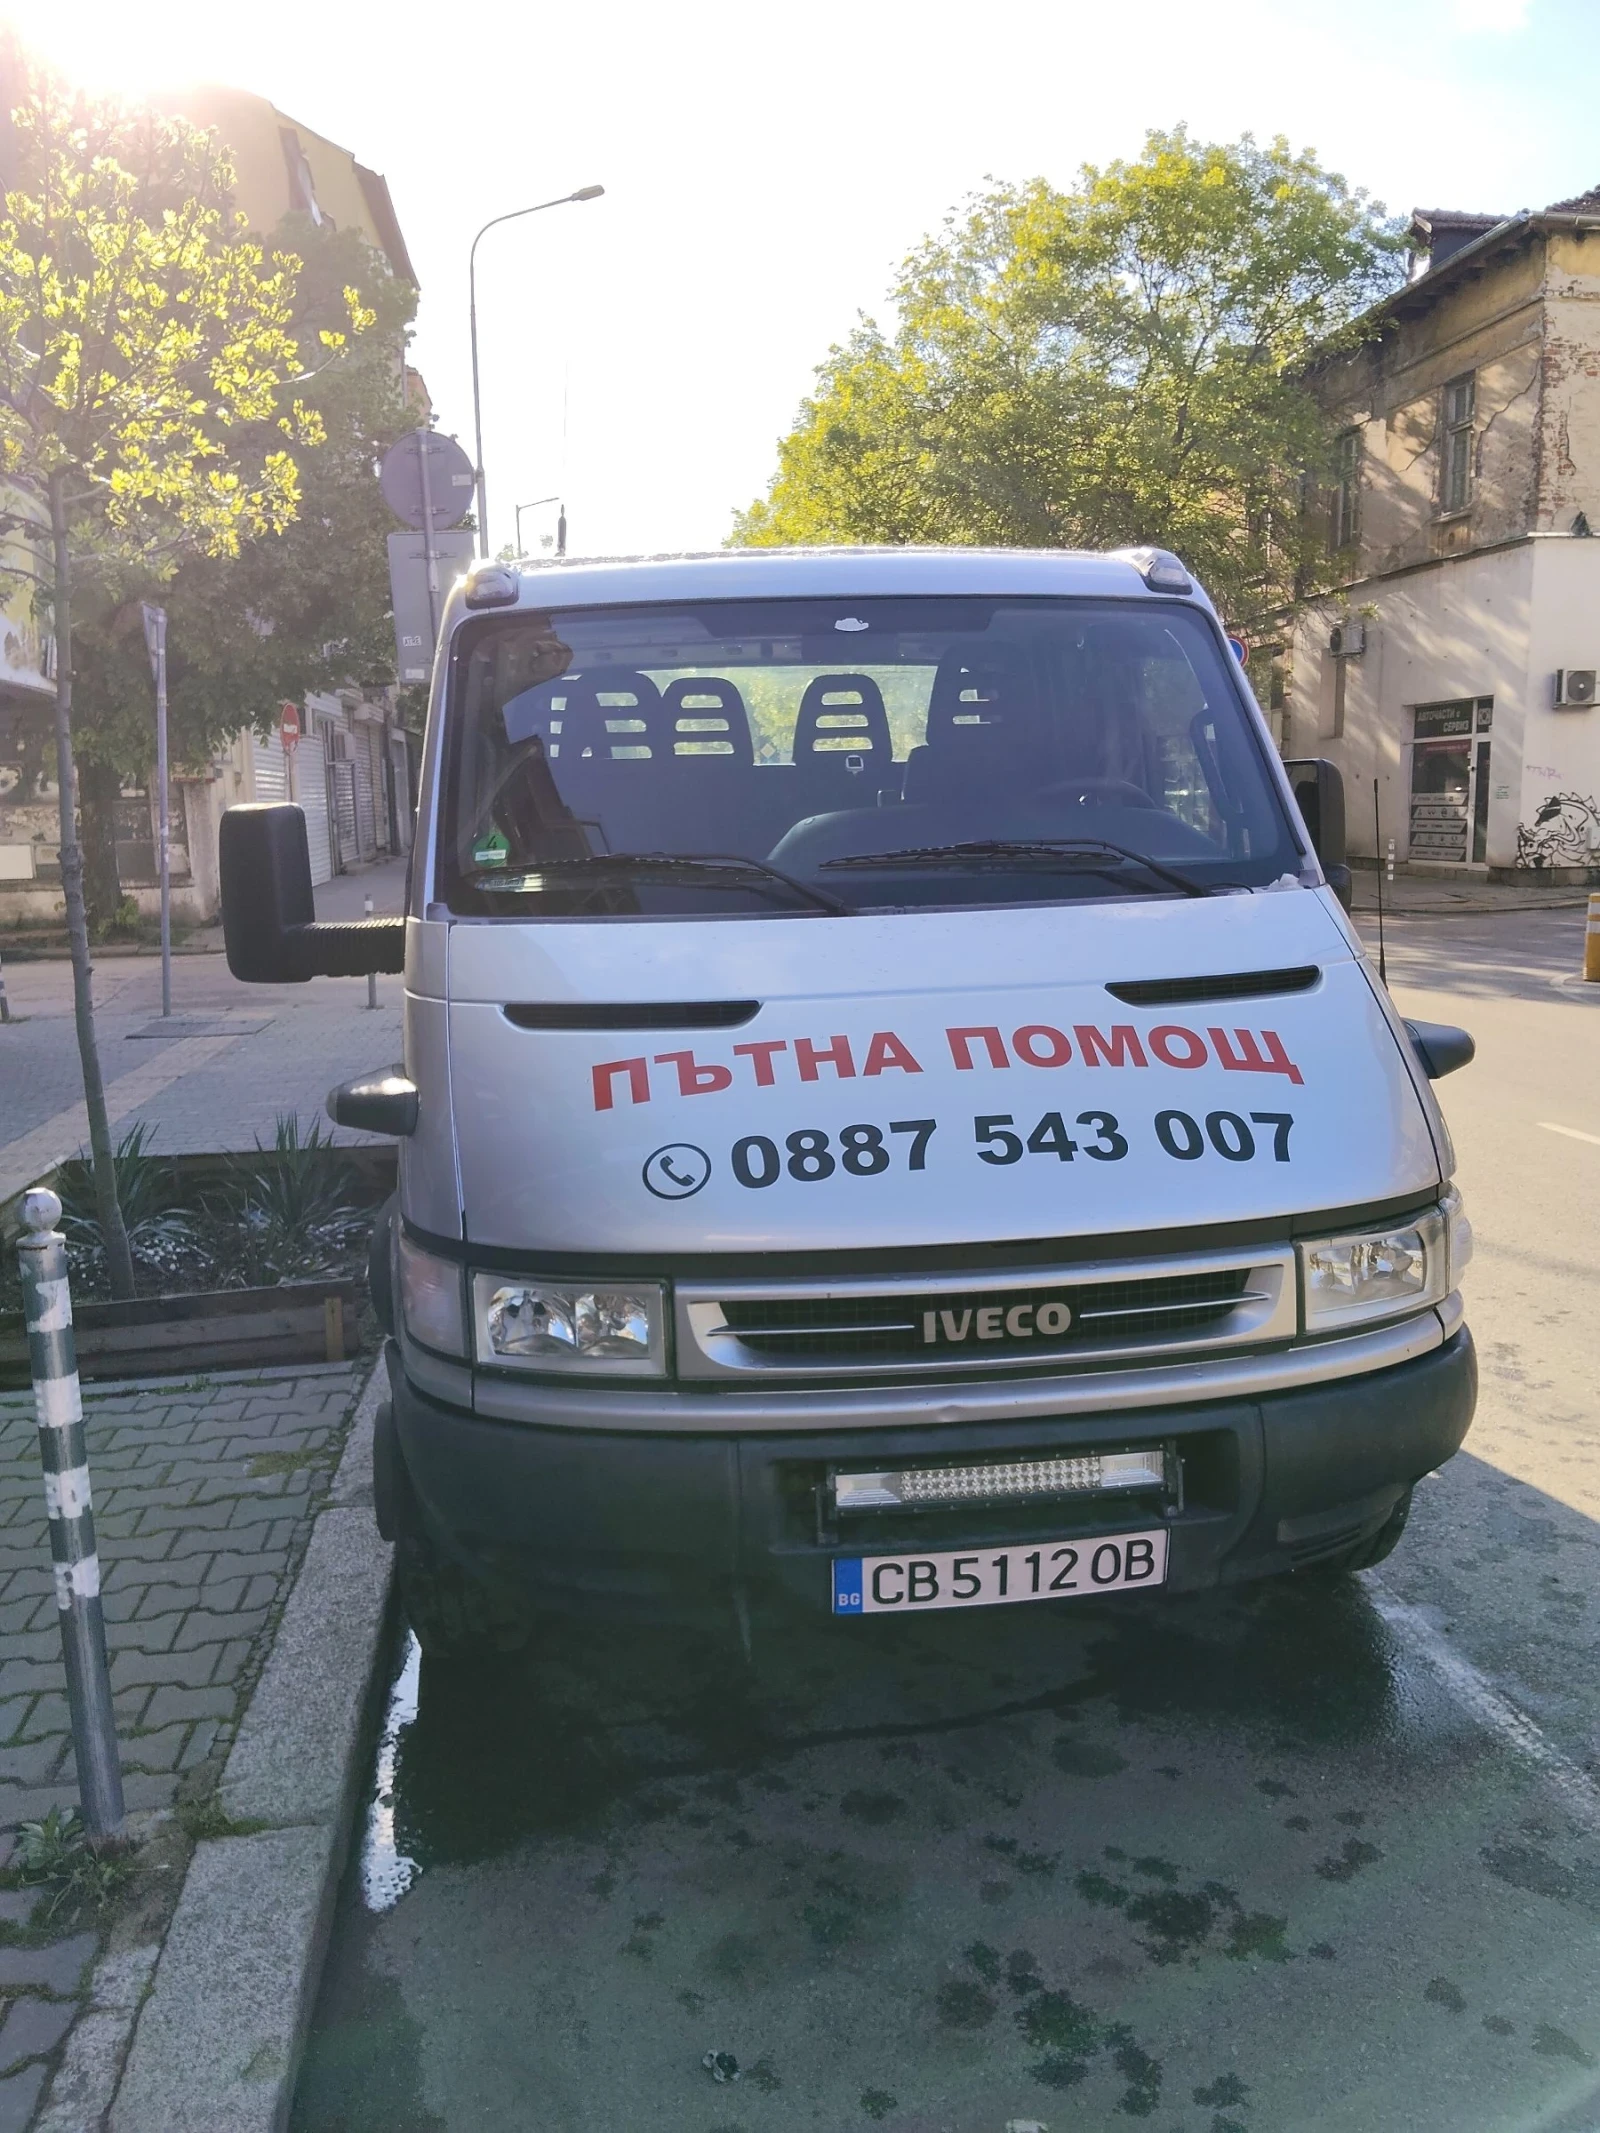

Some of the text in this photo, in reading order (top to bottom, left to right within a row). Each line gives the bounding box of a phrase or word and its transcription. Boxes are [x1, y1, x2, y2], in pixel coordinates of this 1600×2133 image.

[1443, 720, 1469, 732] СЕРВИЗ
[486, 835, 497, 849] 4
[592, 1024, 1305, 1111] ПЪТНА ПОМОЩ
[731, 1109, 1295, 1189] 0887 543 007
[923, 1302, 1072, 1344] IVECO
[838, 1593, 861, 1606] BG
